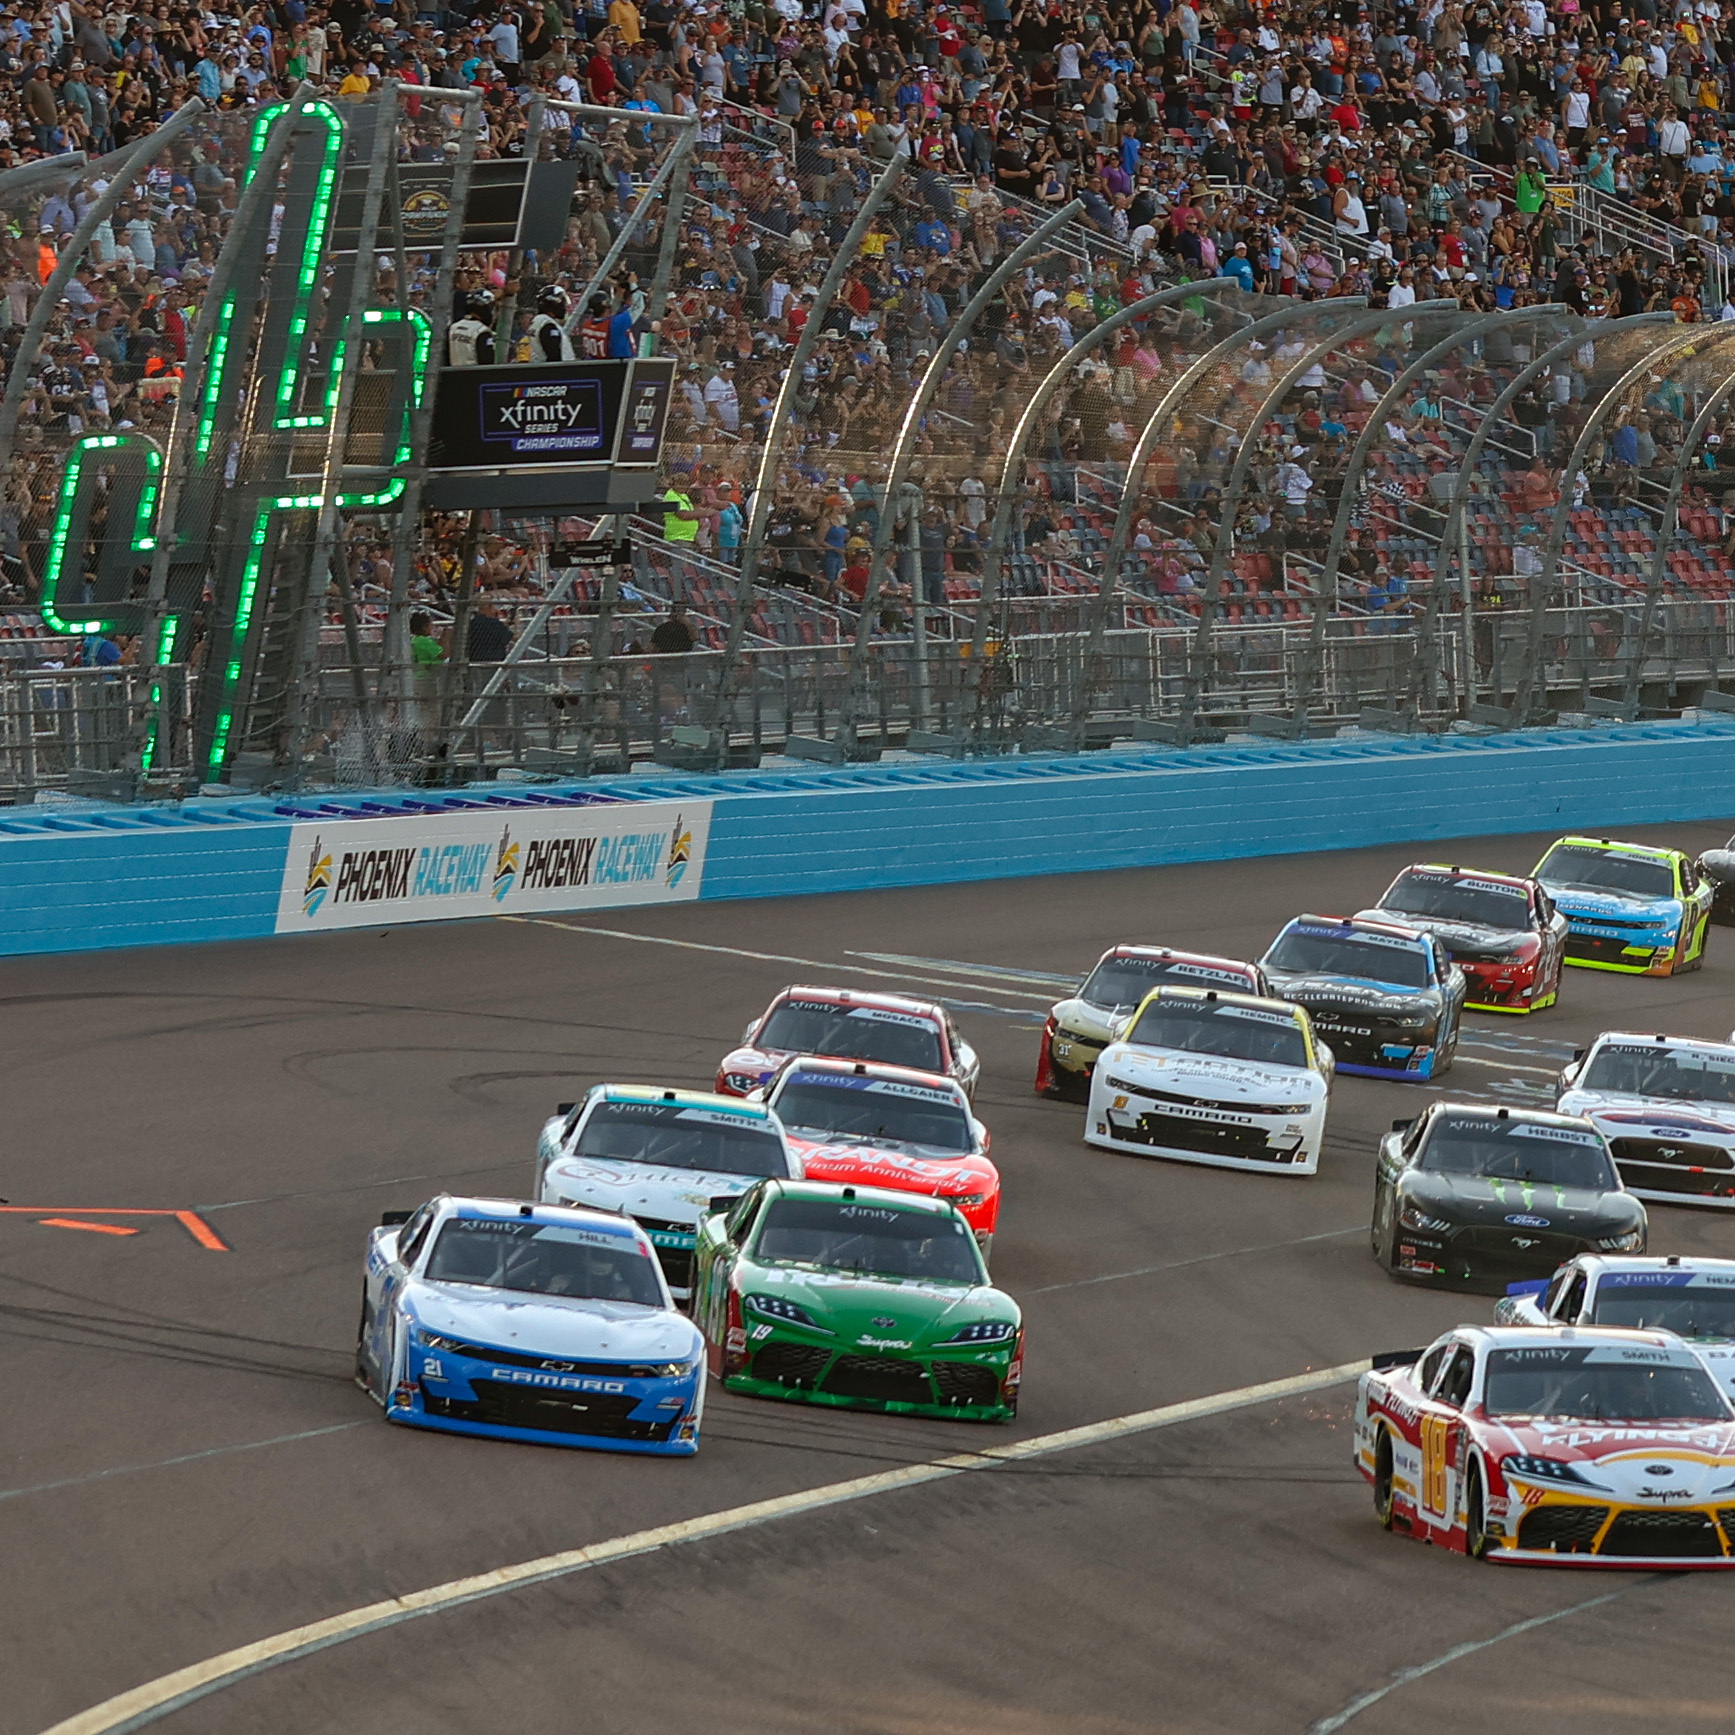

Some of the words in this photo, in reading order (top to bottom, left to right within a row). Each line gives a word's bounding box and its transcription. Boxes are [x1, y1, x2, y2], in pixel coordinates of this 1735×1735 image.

[528, 385, 568, 398] NASCAR
[500, 399, 583, 429] xfinity
[525, 423, 559, 433] SERIES
[516, 436, 600, 450] CHAMPIONSHIP
[334, 848, 417, 903] PHOENIX
[412, 843, 492, 896] RACEWAY
[521, 837, 597, 889] PHOENIX
[592, 832, 667, 884] RACEWAY
[1411, 874, 1451, 884] xfinity
[1466, 881, 1522, 895] BURTON
[1368, 934, 1408, 947] MAYER
[1114, 957, 1162, 969] xfinity
[788, 1000, 840, 1013] xfinity
[871, 1010, 924, 1026] MOSACK
[1159, 999, 1207, 1012] xfinity
[1240, 1010, 1288, 1023] HEMRIC
[1610, 1045, 1657, 1055] xfinity
[803, 1073, 859, 1087] xfinity
[881, 1081, 953, 1102] ALLGAIER
[606, 1102, 665, 1117] xfinity
[709, 1112, 760, 1128] SMITH
[1154, 1104, 1253, 1123] CAMARO
[1448, 1119, 1501, 1132] xfinity
[1527, 1124, 1594, 1143] HERBST
[838, 1206, 900, 1222] xfinity
[1511, 1215, 1546, 1226] Ford
[458, 1218, 525, 1234] xfinity
[578, 1231, 613, 1245] HILL
[1614, 1273, 1675, 1285] xfinity
[856, 1334, 914, 1352] Supra
[1503, 1348, 1571, 1363] xfinity
[1621, 1350, 1670, 1363] SMITH
[422, 1358, 443, 1377] 21
[491, 1368, 625, 1392] CAMARO
[1420, 1414, 1448, 1517] 18
[1520, 1487, 1545, 1505] 18
[1636, 1485, 1694, 1504] Supra
